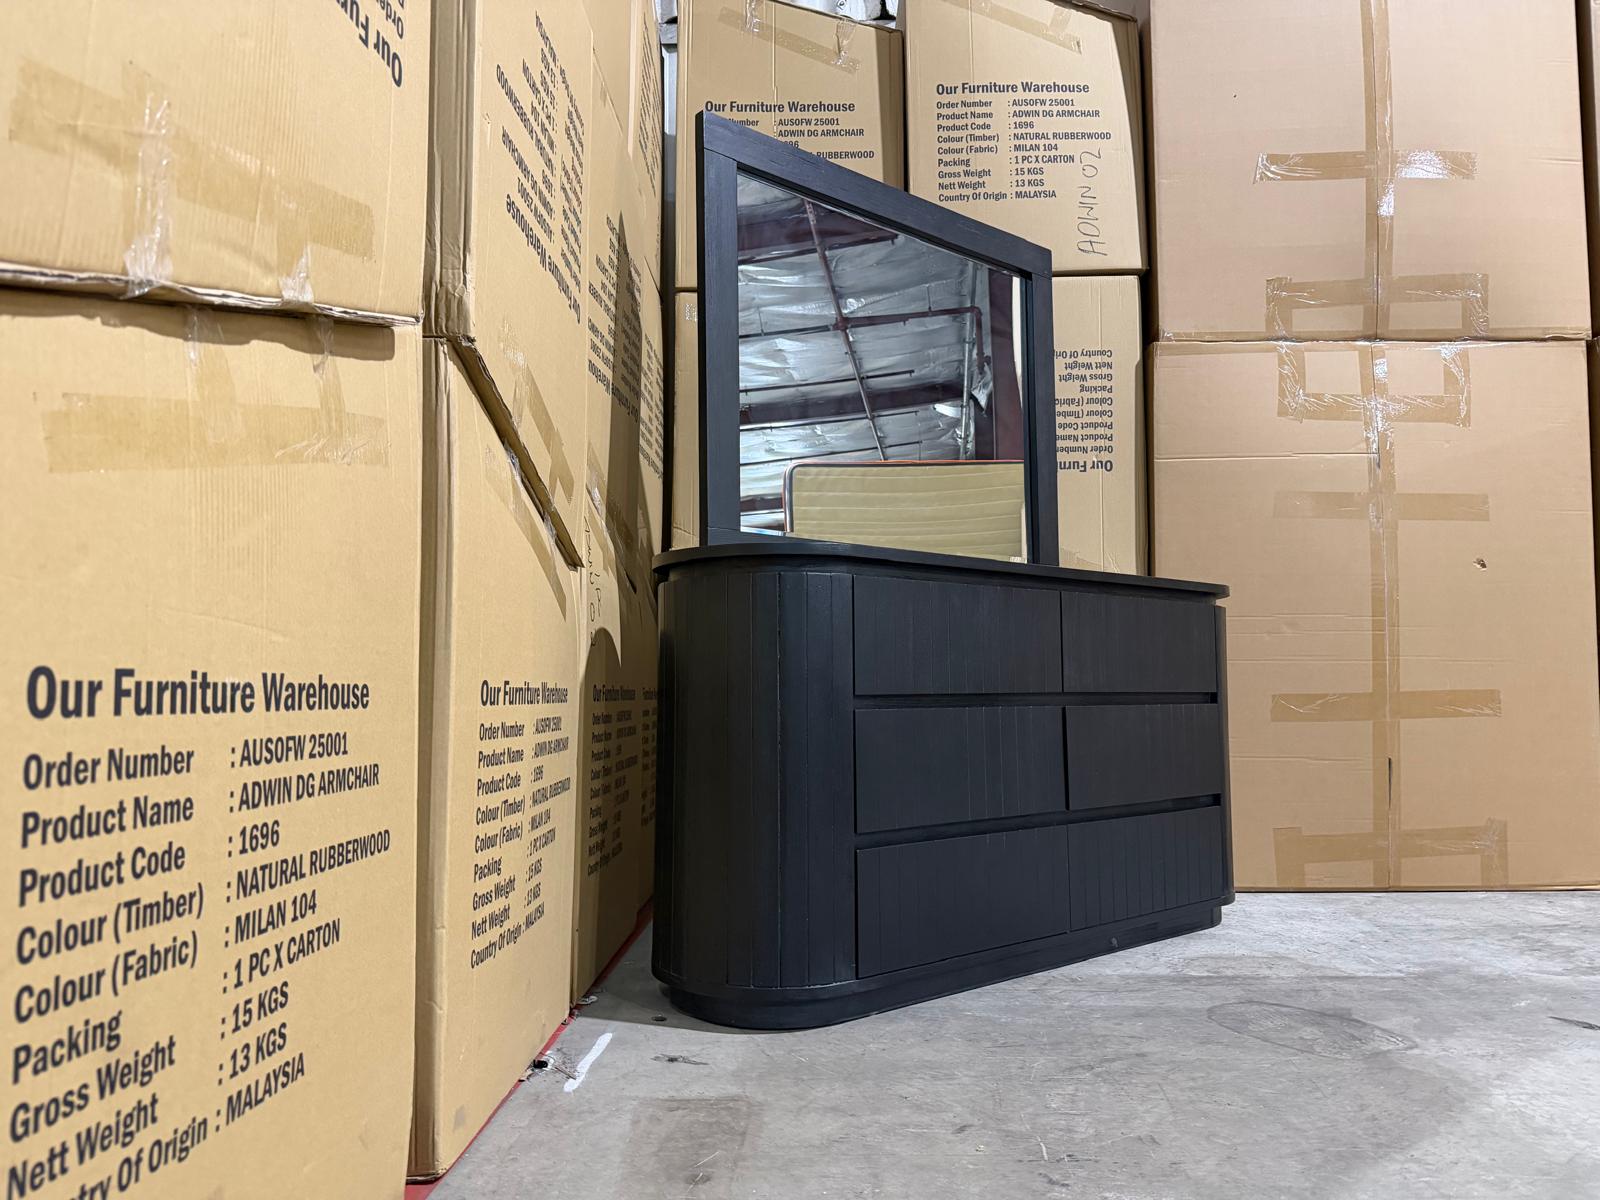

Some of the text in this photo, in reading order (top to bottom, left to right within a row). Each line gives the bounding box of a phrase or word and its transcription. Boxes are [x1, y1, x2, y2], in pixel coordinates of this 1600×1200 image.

[377, 0, 403, 39] Orde
[374, 30, 402, 87] Our
[936, 82, 1089, 95] Our Furniture Warehouse
[705, 101, 855, 112] Our Furniture Warehouse
[937, 101, 959, 109] Order
[961, 100, 992, 108] Number
[1012, 99, 1046, 107] AUSOFW
[814, 118, 840, 126] 25001
[937, 110, 1100, 120] Product Name ADWIN DG ARMCHAIR
[937, 121, 1034, 132] Product Code 1696
[937, 132, 1111, 143] Colour (Timber) NATURAL RUBBERWOOD
[938, 147, 964, 155] Colour
[966, 145, 998, 154] (Fabric)
[1014, 144, 1040, 152] MILAN
[938, 155, 1075, 167] Packing 1 PC X CARTON
[938, 170, 961, 179] Gross
[963, 169, 991, 178] Weight
[938, 179, 1044, 190] Nett Weight 13 KGS
[939, 194, 970, 202] Country
[983, 192, 1007, 201] Origin
[1015, 190, 1057, 198] MALAYSIA
[1070, 351, 1078, 359] Of
[1080, 349, 1112, 358] Country
[1064, 361, 1112, 370] Nett Weight
[1059, 373, 1087, 382] Weight
[1080, 384, 1112, 393] Packing
[1055, 396, 1112, 407] Colour (Fabric
[1057, 409, 1112, 419] Colour (Timbe
[1081, 422, 1113, 430] Product
[1090, 460, 1113, 472] Our
[27, 666, 370, 719] Our Furniture Warehouse
[481, 680, 568, 706] Our Furniture Warehouse
[480, 721, 525, 741] Order Number
[23, 731, 348, 791] Order Number AUSOFW 25001
[478, 747, 524, 769] Product Name
[477, 776, 504, 797] Product
[506, 771, 521, 790] Code
[21, 763, 380, 849] Product Name ADWIN DG ARMCHAIR
[476, 795, 525, 826] Colour (Timber)
[475, 828, 498, 854] Colour
[499, 821, 523, 848] (Fabric)
[19, 820, 280, 907] Product Code 1696
[474, 856, 502, 883] Packing
[16, 829, 390, 965] Colour (Timber) NATURAL RUBBERWOOD
[473, 886, 493, 911] Gross
[494, 874, 515, 899] Weight
[472, 915, 487, 940] Nett
[488, 904, 510, 933] Weight
[15, 885, 317, 1024] Colour (Fabric) MILAN 104
[471, 939, 497, 969] Country
[498, 930, 506, 950] Of
[506, 922, 521, 945] Origin
[12, 918, 341, 1085] Packing 1 PC X CARTON
[9, 981, 289, 1143] Gross Weight 15 KGS
[7, 1141, 69, 1200] Nett
[75, 1092, 158, 1166] Weight
[229, 1043, 251, 1080] 13
[255, 1021, 287, 1063] KGS
[118, 1147, 144, 1192] Of
[148, 1116, 208, 1174] Origin
[224, 1052, 305, 1126] MALAYSIA
